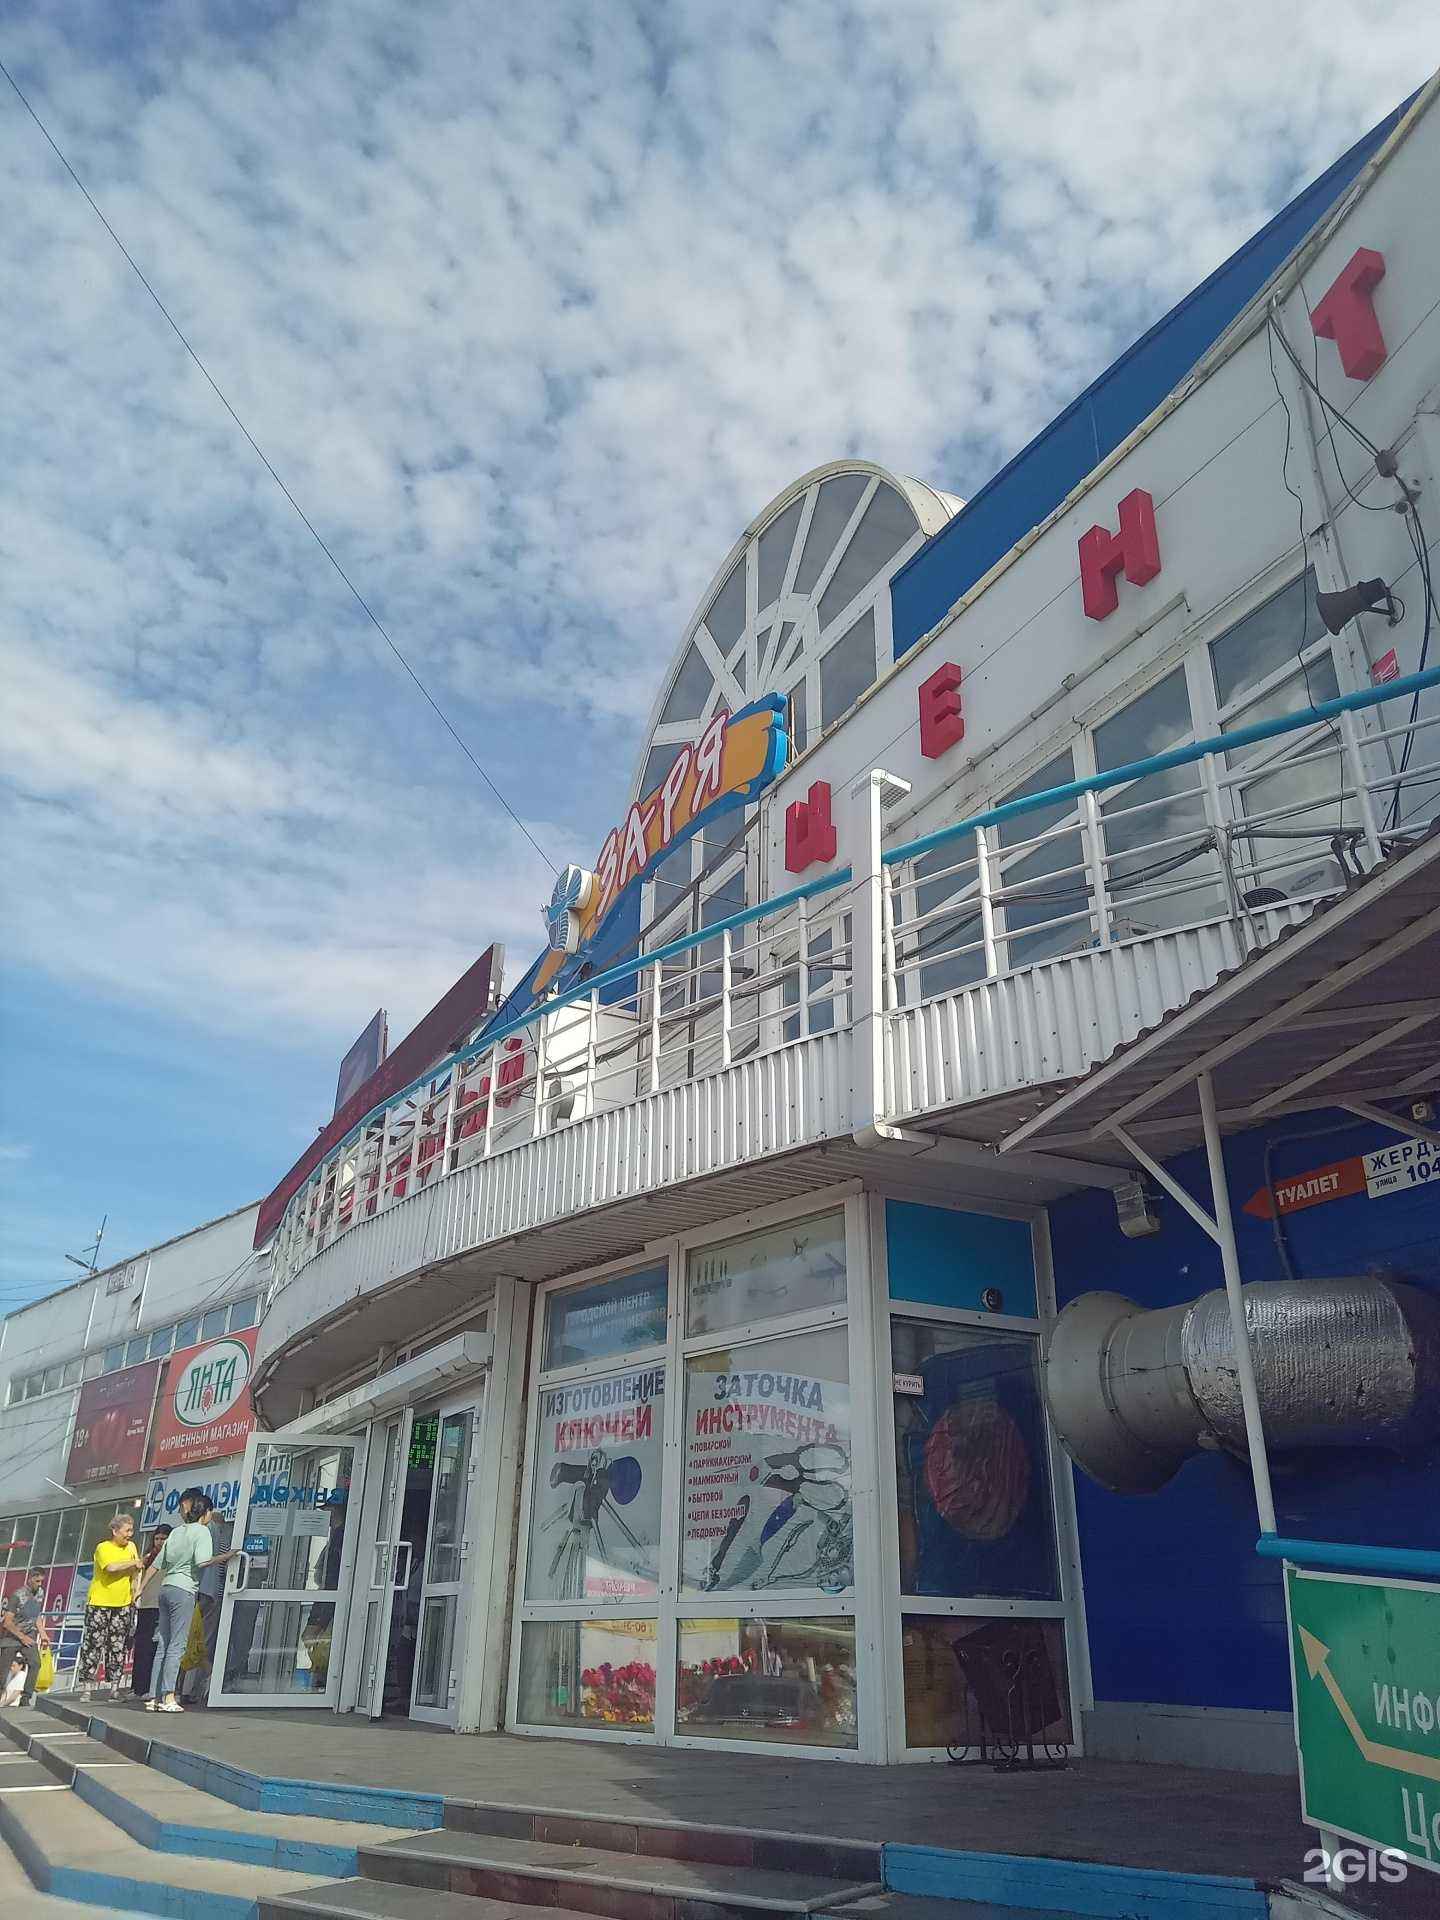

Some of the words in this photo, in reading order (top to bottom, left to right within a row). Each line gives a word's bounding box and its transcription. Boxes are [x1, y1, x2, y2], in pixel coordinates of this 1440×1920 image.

[596, 709, 731, 920] ЗАРЯ
[1276, 1173, 1339, 1206] ТУАЛЕТ
[1375, 1175, 1398, 1190] улица
[184, 1356, 238, 1412] ЯНТА
[545, 1370, 664, 1417] ИЗГОТОВЛЕНИЕ
[714, 1373, 824, 1412] ЗАТОЧКА
[159, 1426, 209, 1451] ФИРМЕННЫЙ
[210, 1420, 249, 1441] МАГАЗИН
[554, 1398, 653, 1453] КЛЮЧЕЙ
[695, 1403, 838, 1443] ИНСТРУМЕНТА
[694, 1437, 732, 1453] ПОВАРСКОЙ
[692, 1489, 723, 1504] БЫТОВОЙ
[691, 1510, 709, 1521] ЦЕПИ
[691, 1526, 727, 1540] ЛЕДОБУРЫ
